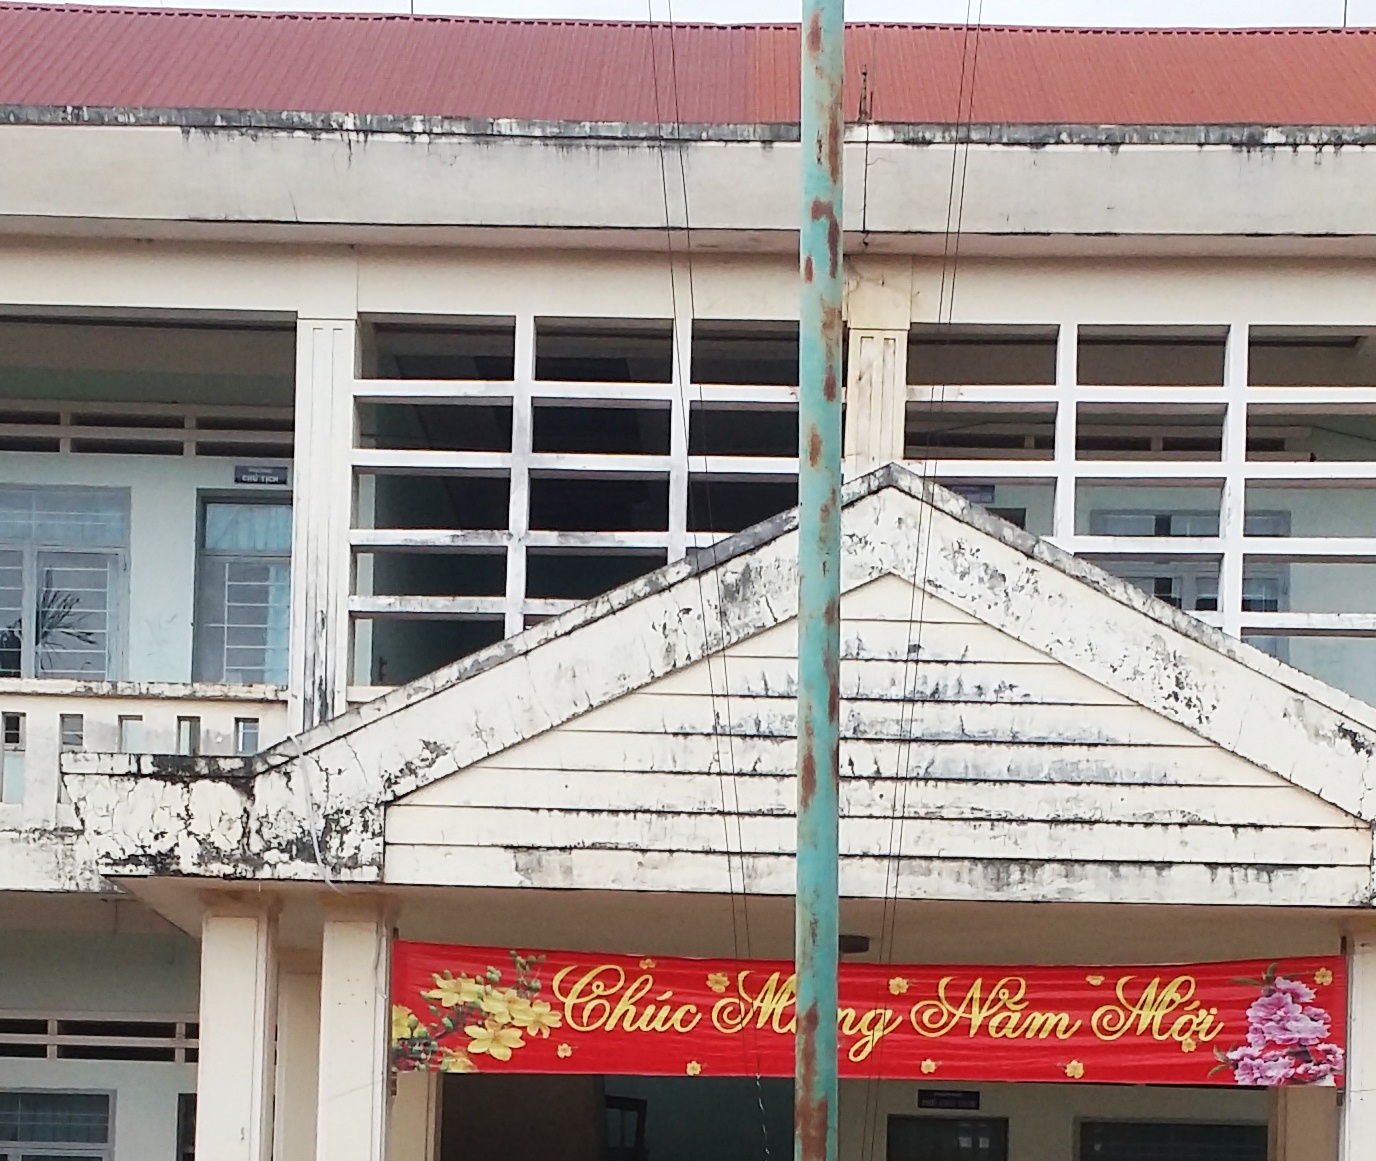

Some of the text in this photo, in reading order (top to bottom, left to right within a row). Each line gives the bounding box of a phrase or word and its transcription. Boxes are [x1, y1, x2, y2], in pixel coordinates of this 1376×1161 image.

[552, 964, 1225, 1062] Chúc Mng Năm Mới
